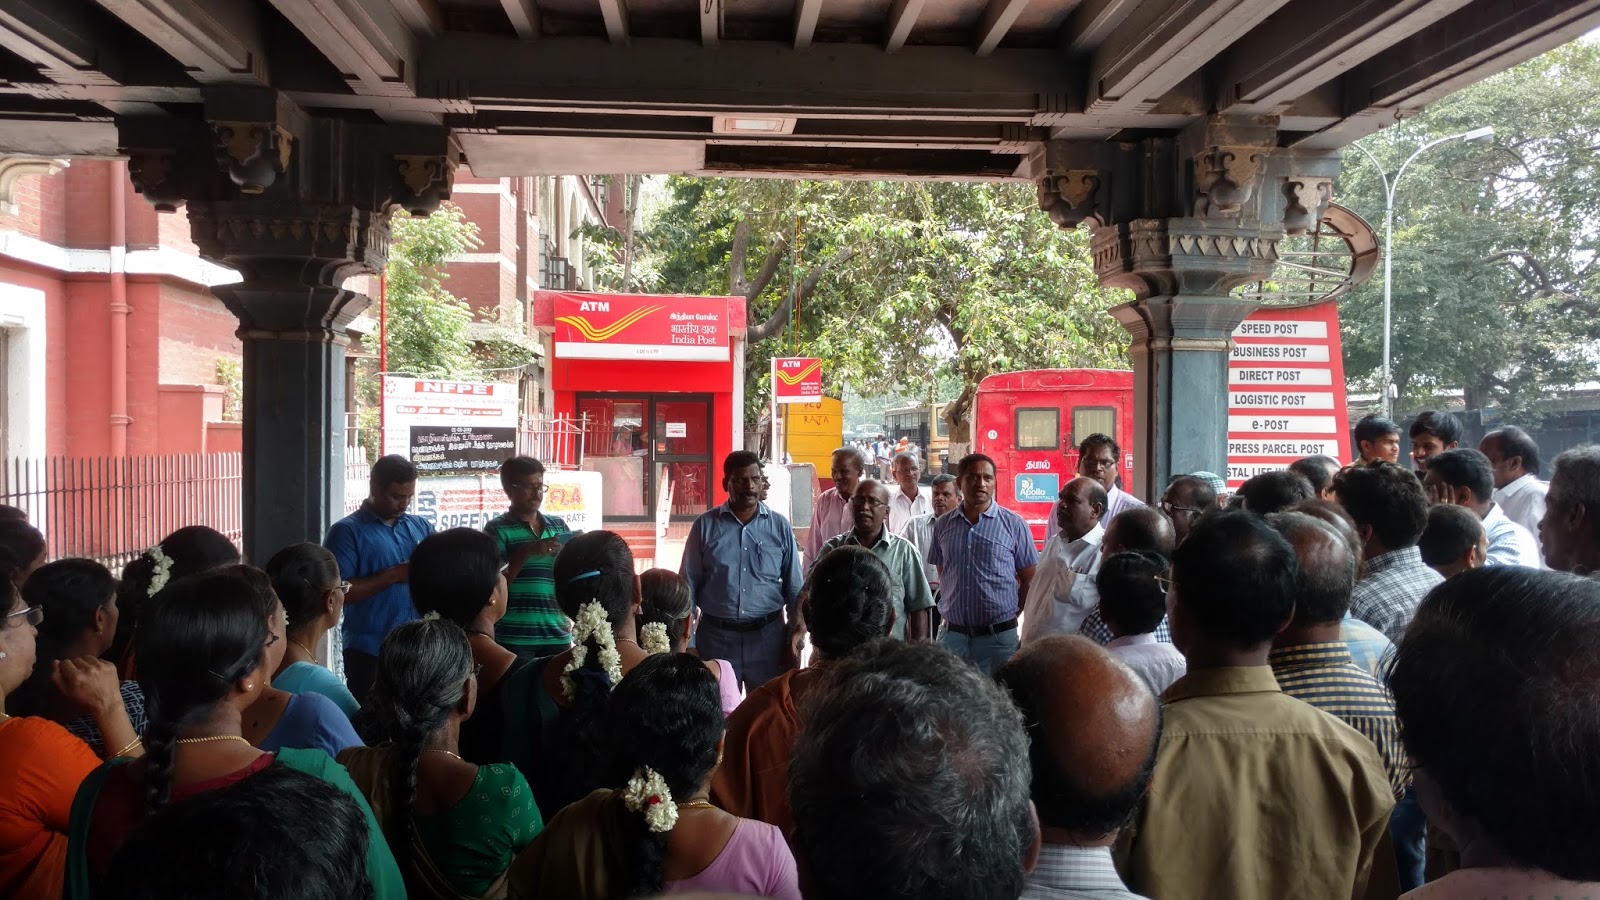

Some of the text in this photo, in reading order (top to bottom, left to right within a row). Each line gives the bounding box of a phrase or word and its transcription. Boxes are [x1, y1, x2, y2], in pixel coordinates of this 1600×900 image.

[580, 301, 610, 312] ATM
[671, 322, 717, 335] भारतीय डाक
[1241, 324, 1298, 334] SPEED POST
[671, 334, 717, 344] India Post
[1233, 347, 1307, 358] BUSINESS POST
[1239, 370, 1301, 381] DIRECT POST
[423, 382, 488, 395] NFPE
[1234, 395, 1306, 406] LOGISTIC POST
[804, 415, 829, 426] RAJA
[1252, 420, 1289, 430] e-POST
[1228, 444, 1324, 454] PRESS PARCEL POST
[1025, 459, 1051, 470] தபால்
[1020, 488, 1046, 499] Apollo
